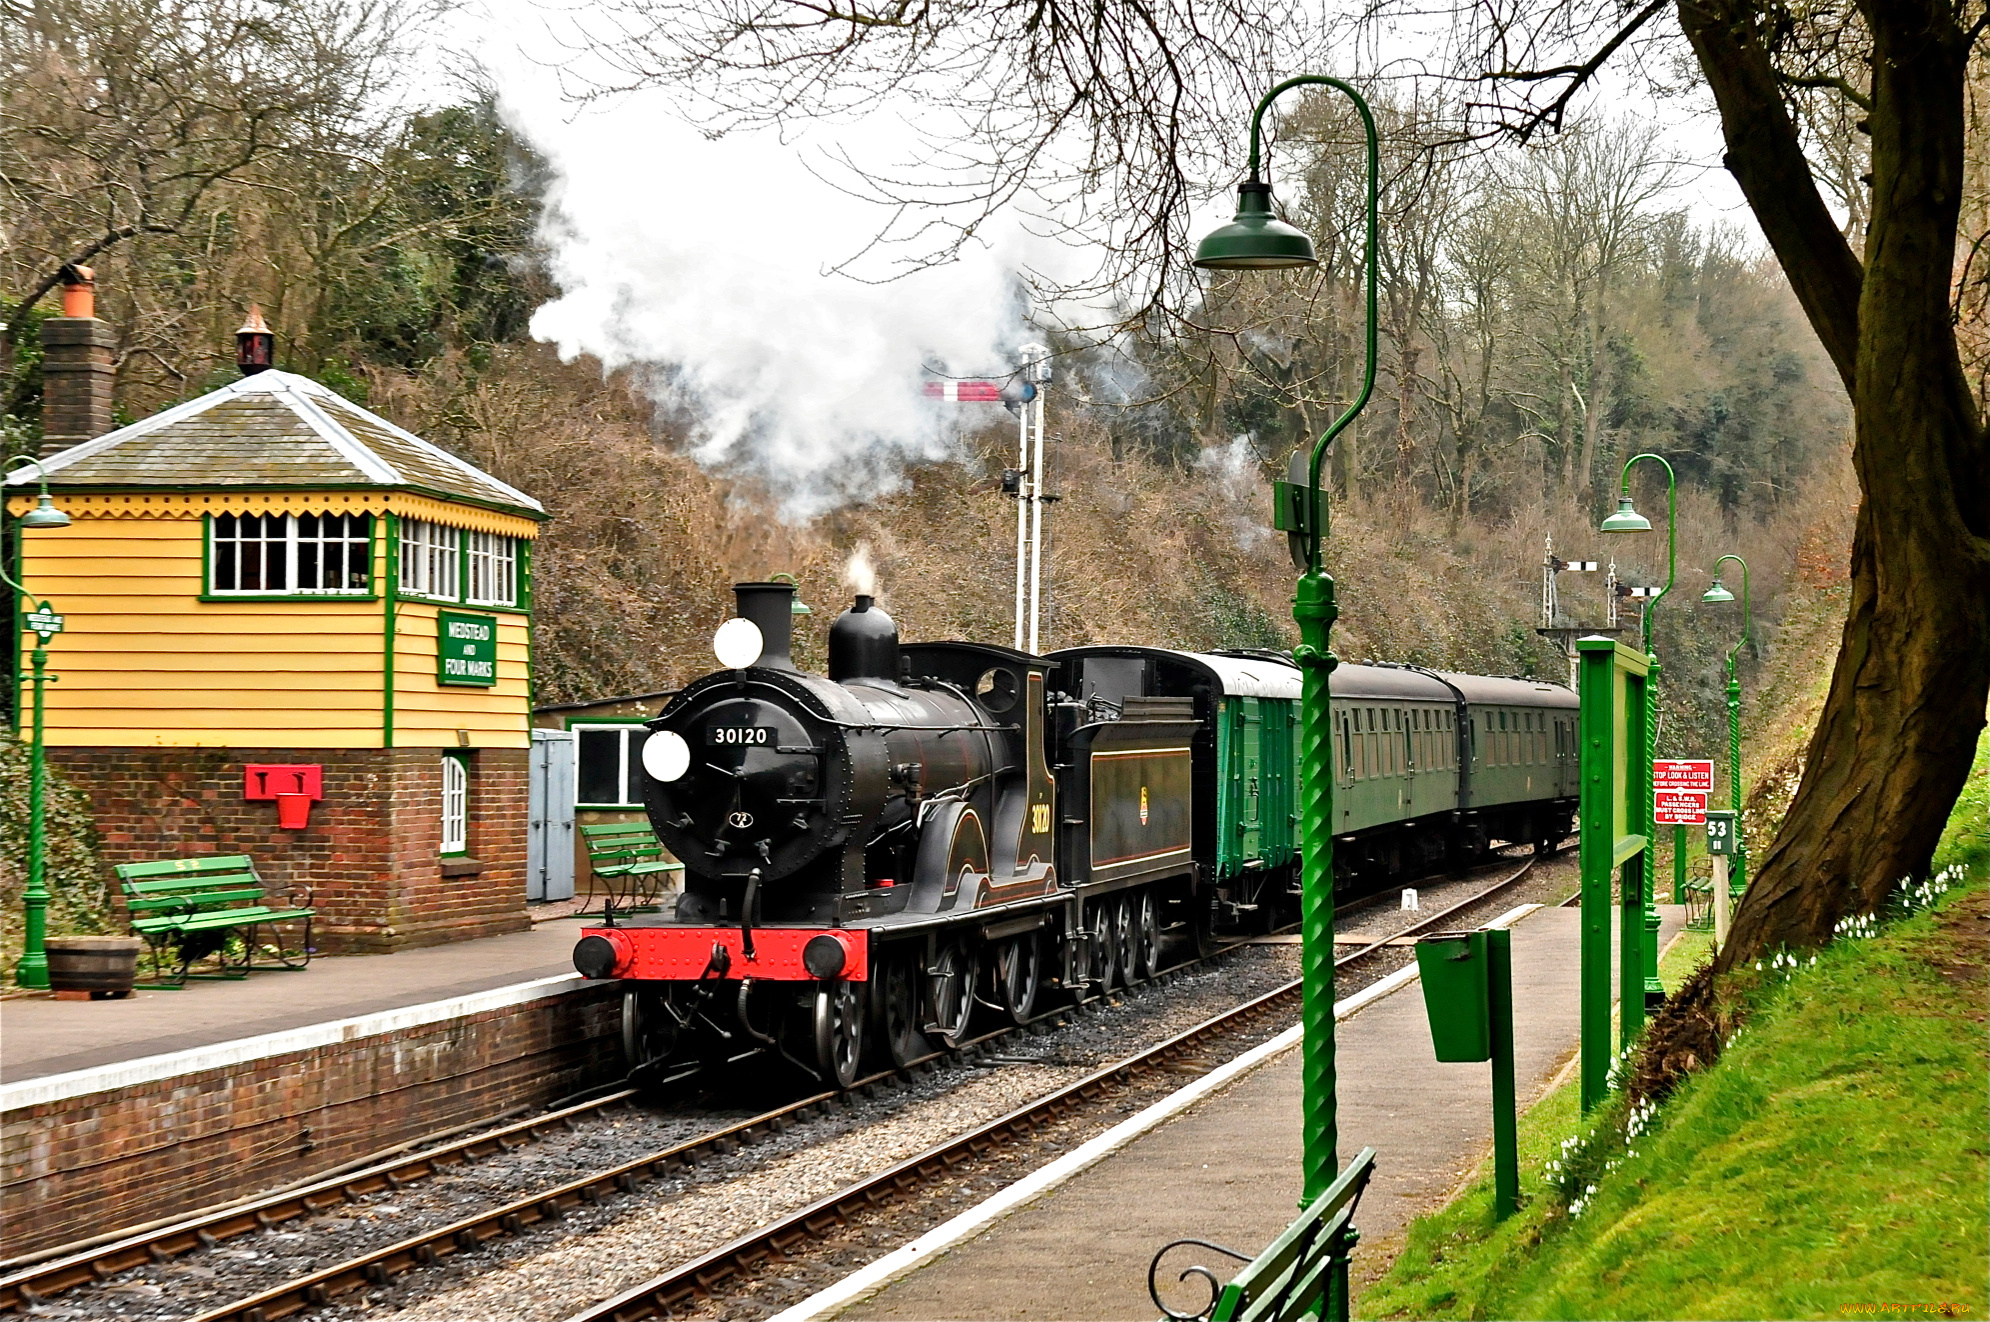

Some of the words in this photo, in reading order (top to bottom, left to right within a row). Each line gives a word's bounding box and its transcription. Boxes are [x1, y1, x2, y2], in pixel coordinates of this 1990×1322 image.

[448, 621, 490, 641] MEDSTEAD
[463, 644, 476, 656] AND
[445, 658, 467, 676] FOUR
[467, 660, 493, 678] MARKS
[715, 728, 767, 744] 30120
[1667, 771, 1682, 779] LOOK
[1688, 772, 1709, 780] LISTEN
[1032, 803, 1050, 834] 30120
[1707, 821, 1726, 837] 53
